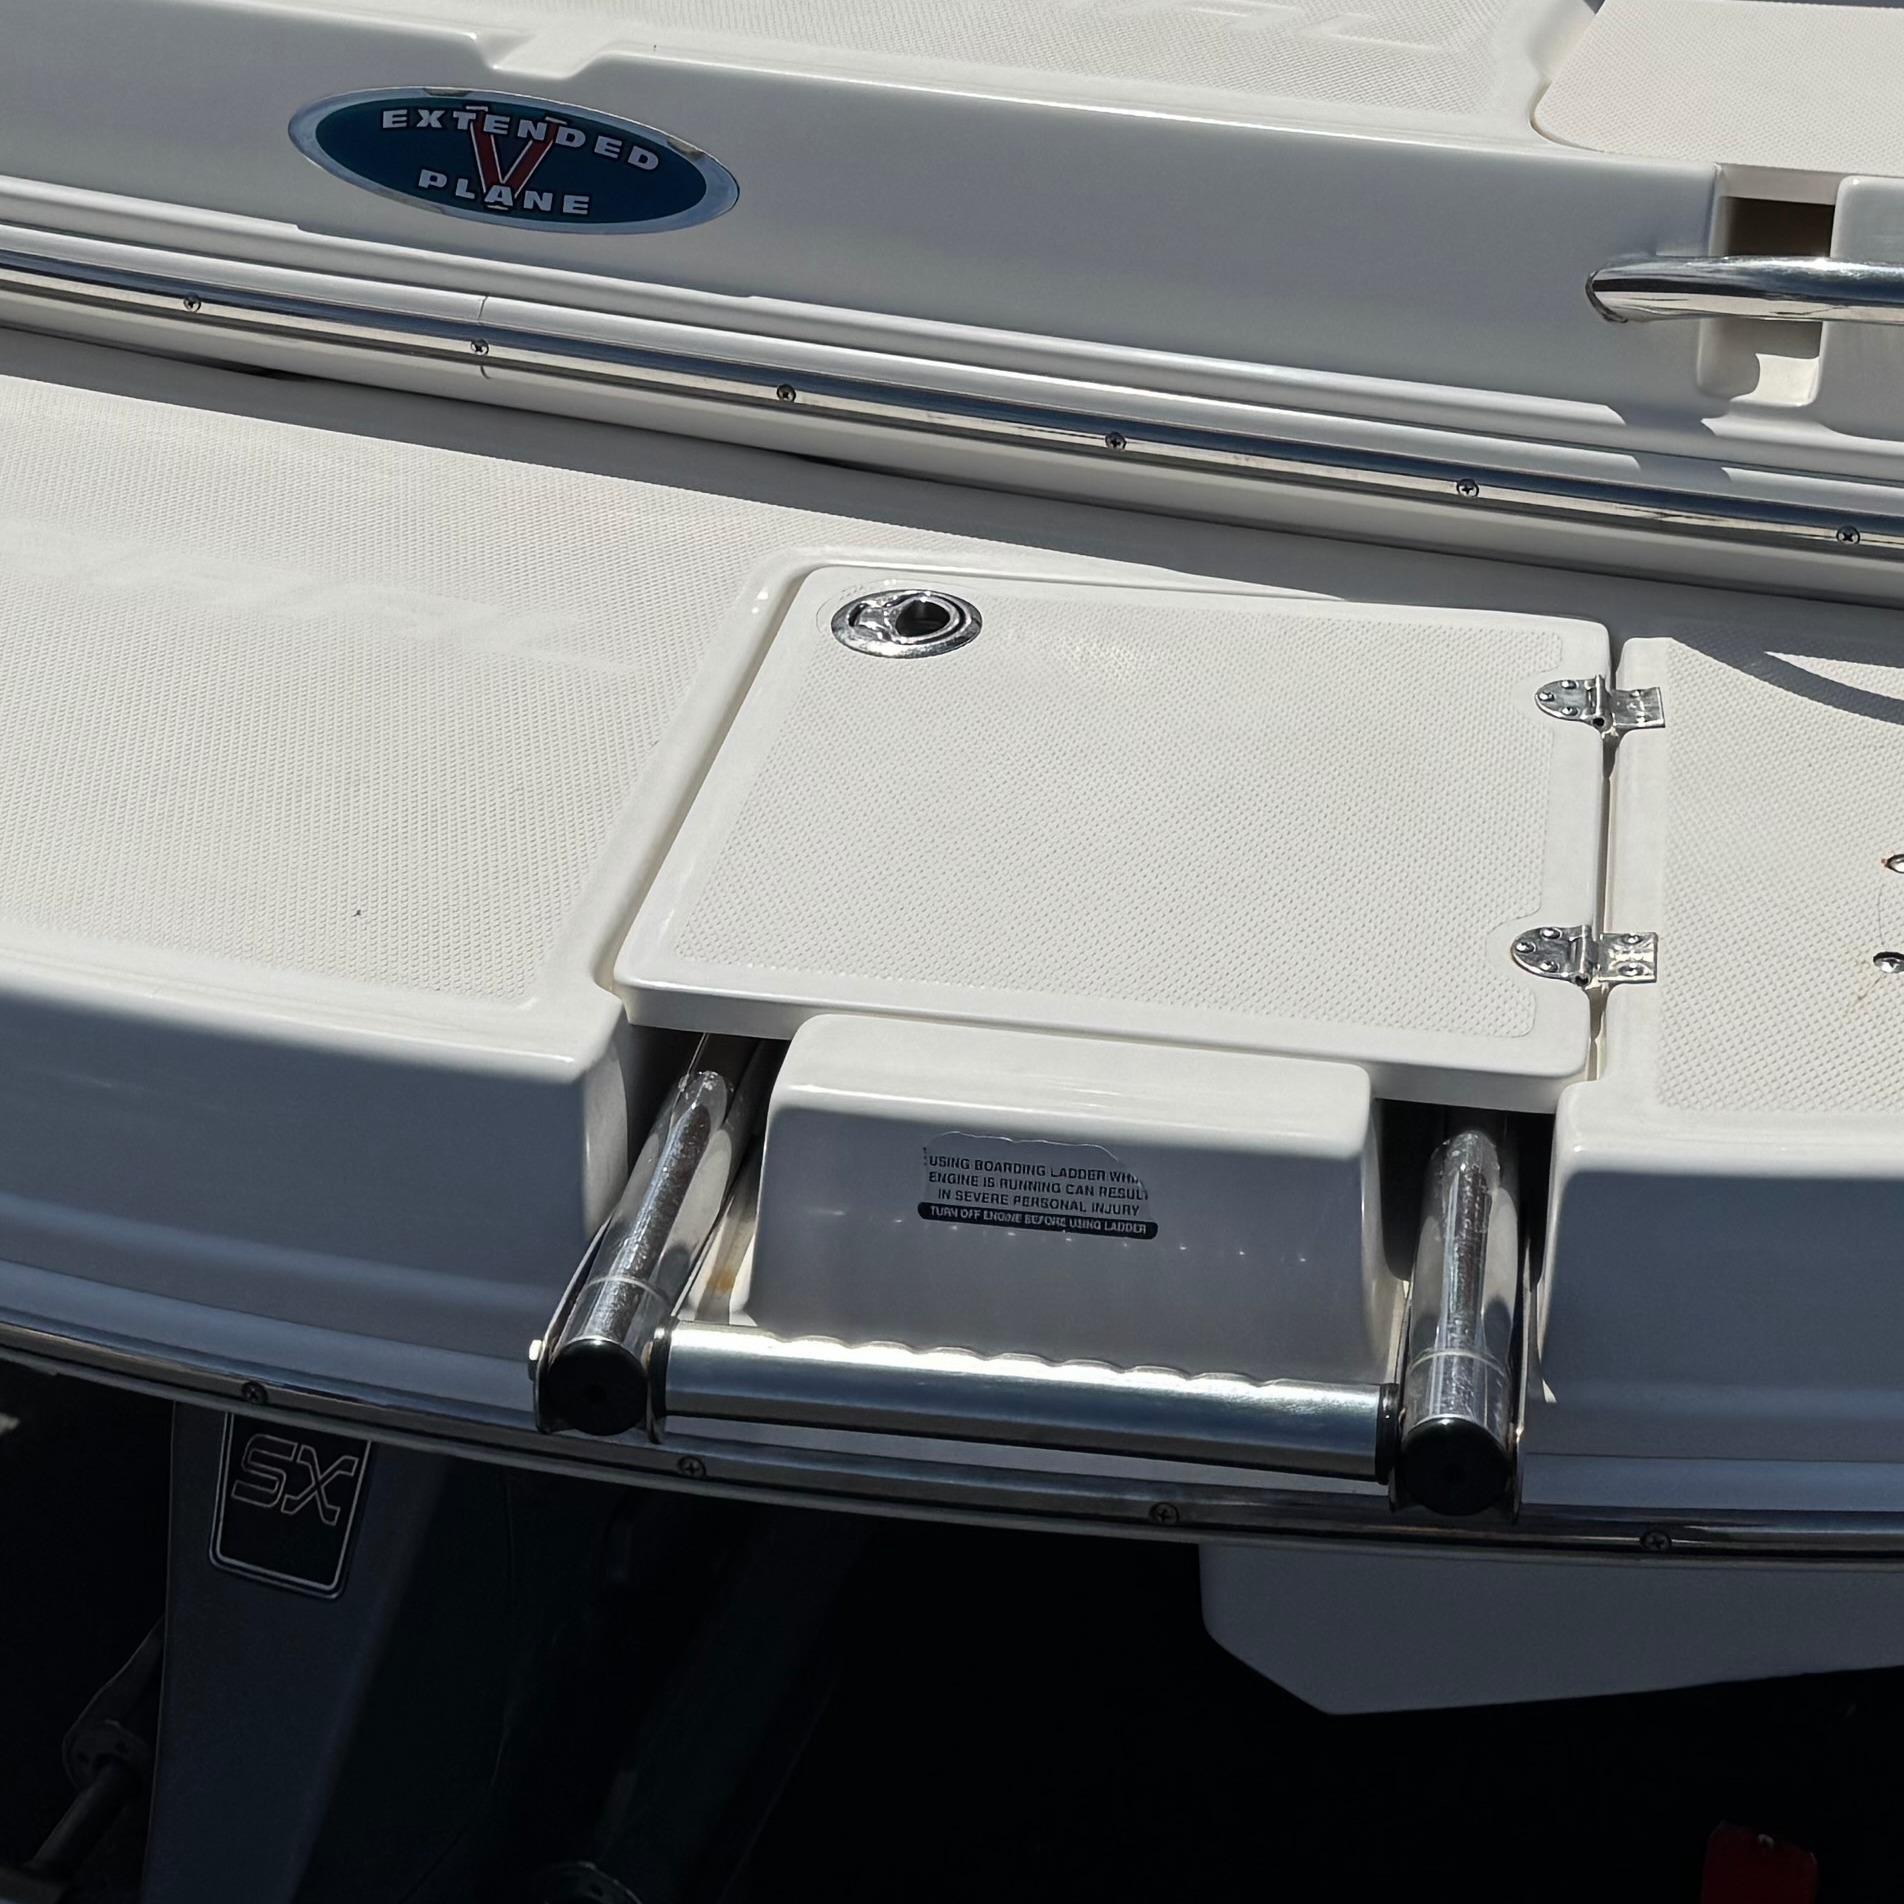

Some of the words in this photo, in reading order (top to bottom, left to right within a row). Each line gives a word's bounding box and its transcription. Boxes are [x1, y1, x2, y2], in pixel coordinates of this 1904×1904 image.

[381, 107, 660, 172] EXTENDED
[417, 168, 591, 216] PLANE
[928, 1154, 969, 1169] USING
[974, 1157, 1045, 1177] BOARDING
[1050, 1164, 1105, 1182] LADDER
[1108, 1171, 1138, 1184] WHI
[928, 1170, 978, 1186] ENGINE
[983, 1176, 994, 1187] IS
[999, 1176, 1059, 1194] RUNNING
[1065, 1182, 1094, 1197] CAN
[938, 1188, 950, 1199] IN
[955, 1189, 1008, 1205] SEVERE
[1013, 1193, 1086, 1212] PERSONAL
[1091, 1200, 1139, 1217] INJURY
[930, 1205, 957, 1217] TURN
[1104, 1220, 1146, 1234] LADDER
[230, 1432, 360, 1527] SX
